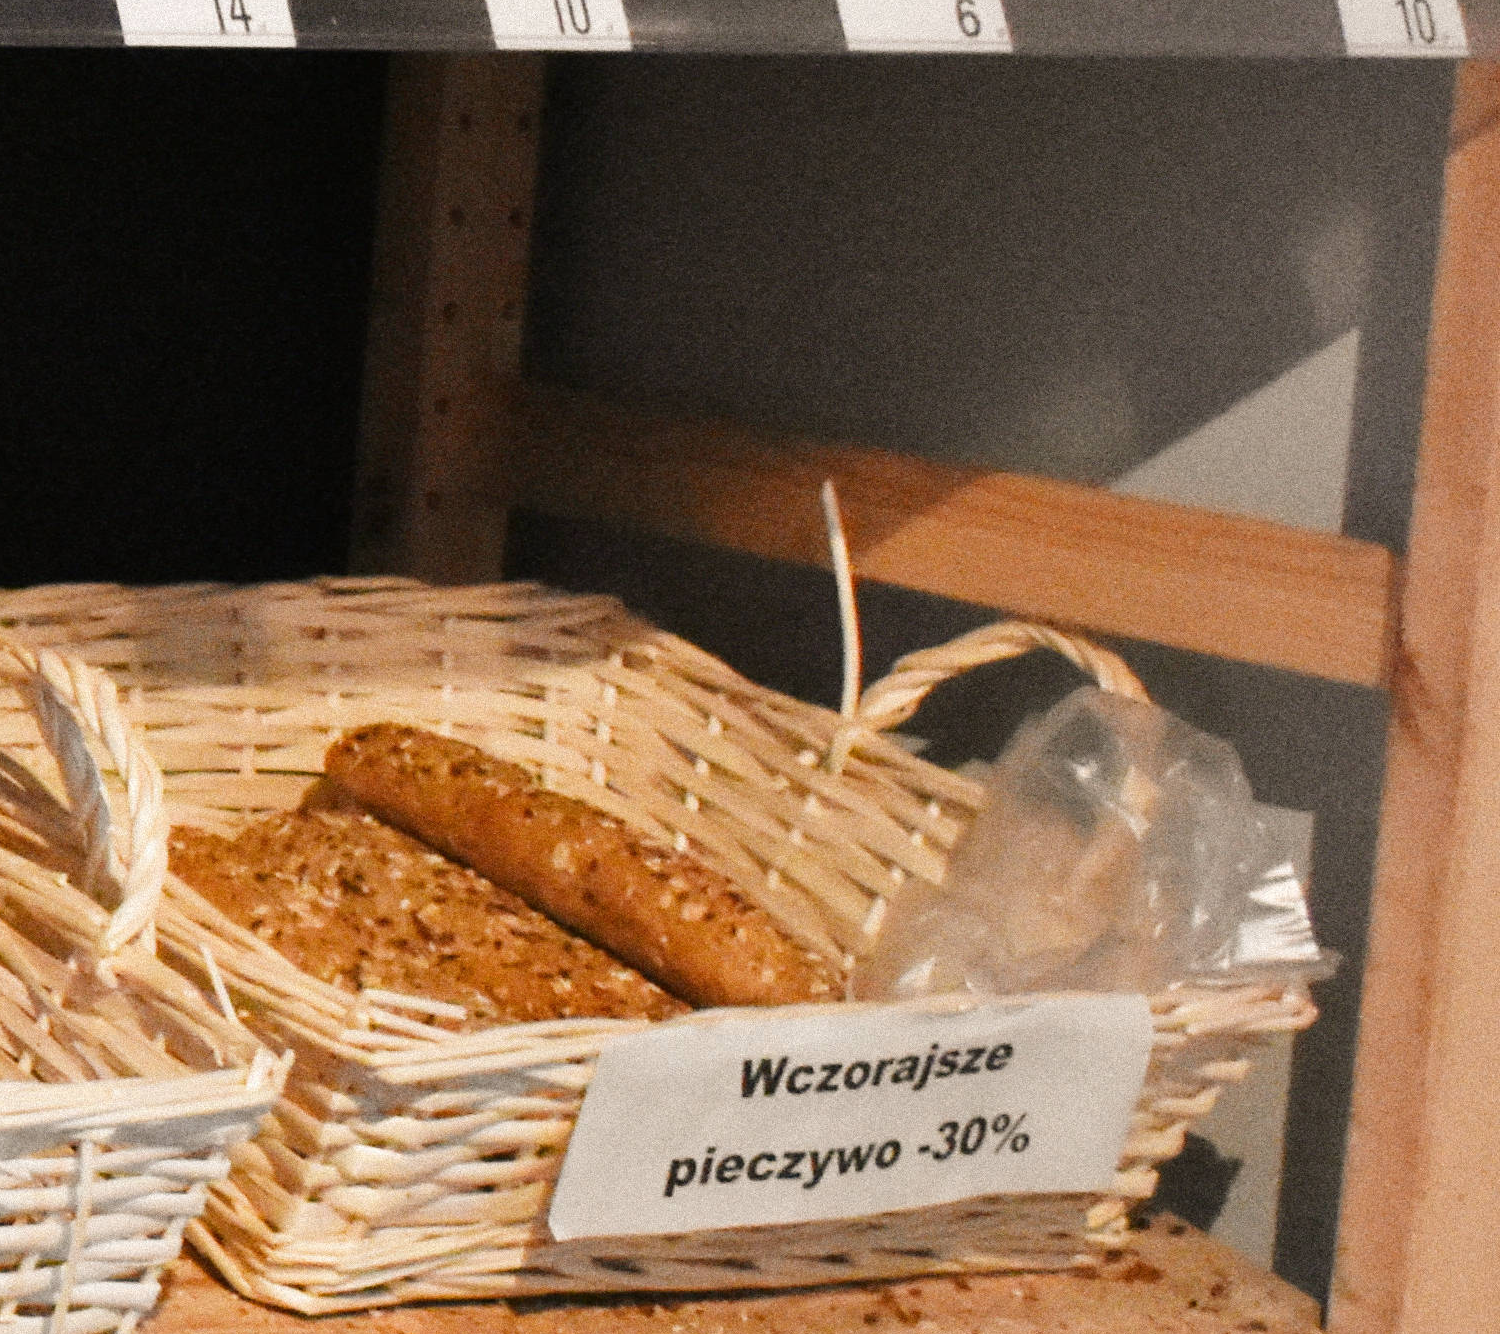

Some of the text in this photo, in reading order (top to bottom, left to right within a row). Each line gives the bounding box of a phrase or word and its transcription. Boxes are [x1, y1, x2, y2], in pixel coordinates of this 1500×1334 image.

[739, 1040, 1015, 1100] Wczorajsze
[664, 1111, 1032, 1199] pieczywo -30%
